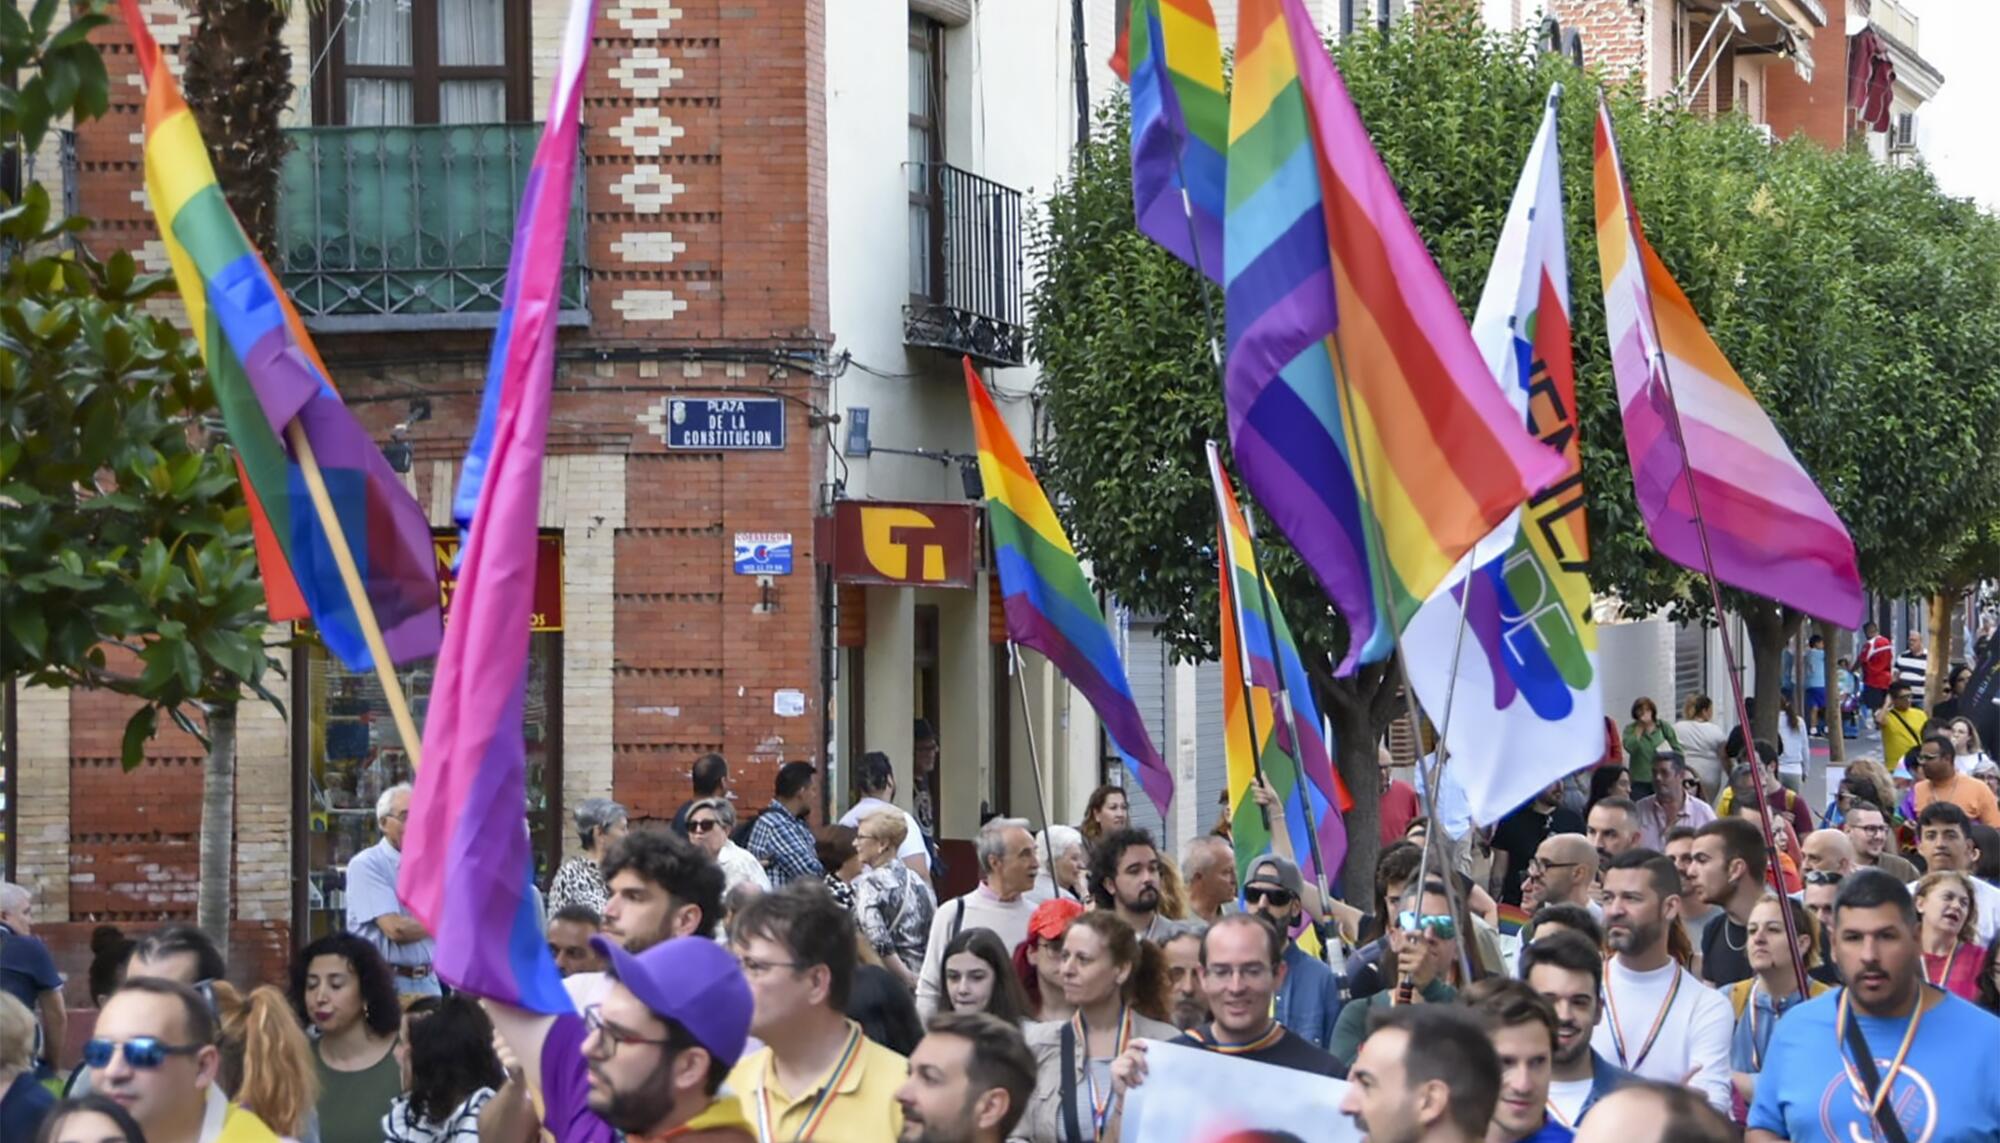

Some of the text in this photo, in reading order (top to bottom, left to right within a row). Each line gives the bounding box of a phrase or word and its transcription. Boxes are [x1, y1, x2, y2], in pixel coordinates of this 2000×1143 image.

[707, 400, 746, 412] PLAZA
[709, 415, 746, 430] DE LA
[683, 430, 772, 446] CONSTITUCION
